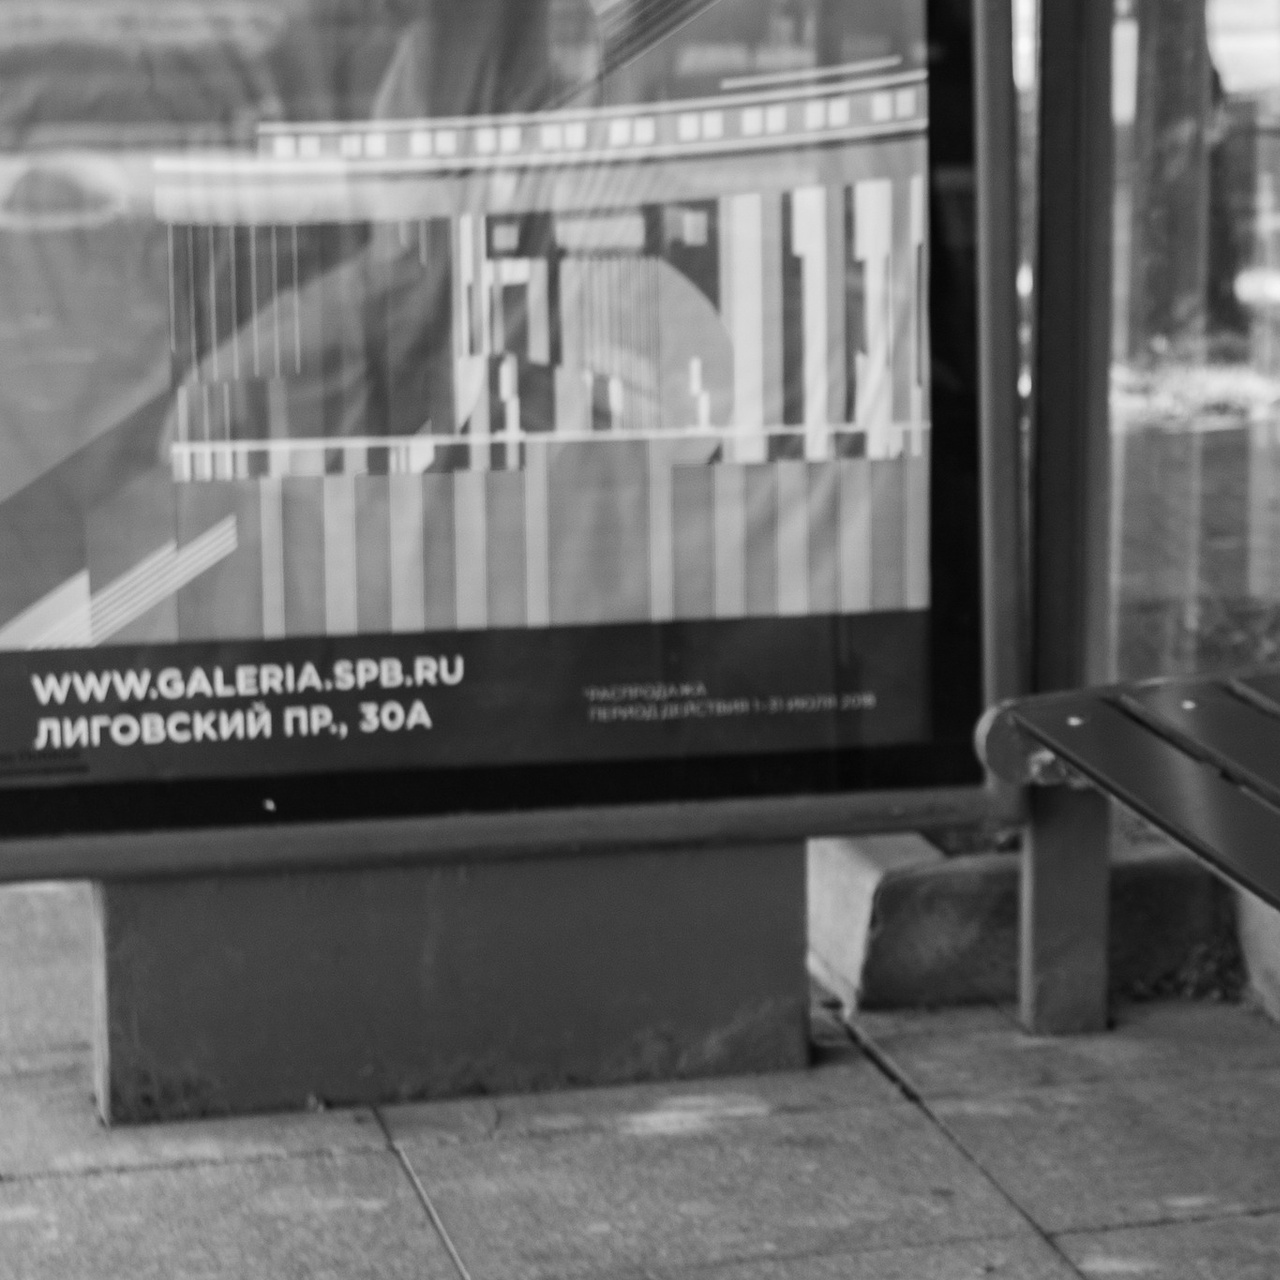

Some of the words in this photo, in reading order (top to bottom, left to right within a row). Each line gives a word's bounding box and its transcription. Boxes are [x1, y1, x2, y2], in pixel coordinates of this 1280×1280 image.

[32, 655, 464, 705] WWW.GALERIA.SPB.RU
[34, 700, 272, 749] ЛИГОВСКИЙ
[283, 705, 348, 739] ПР.,
